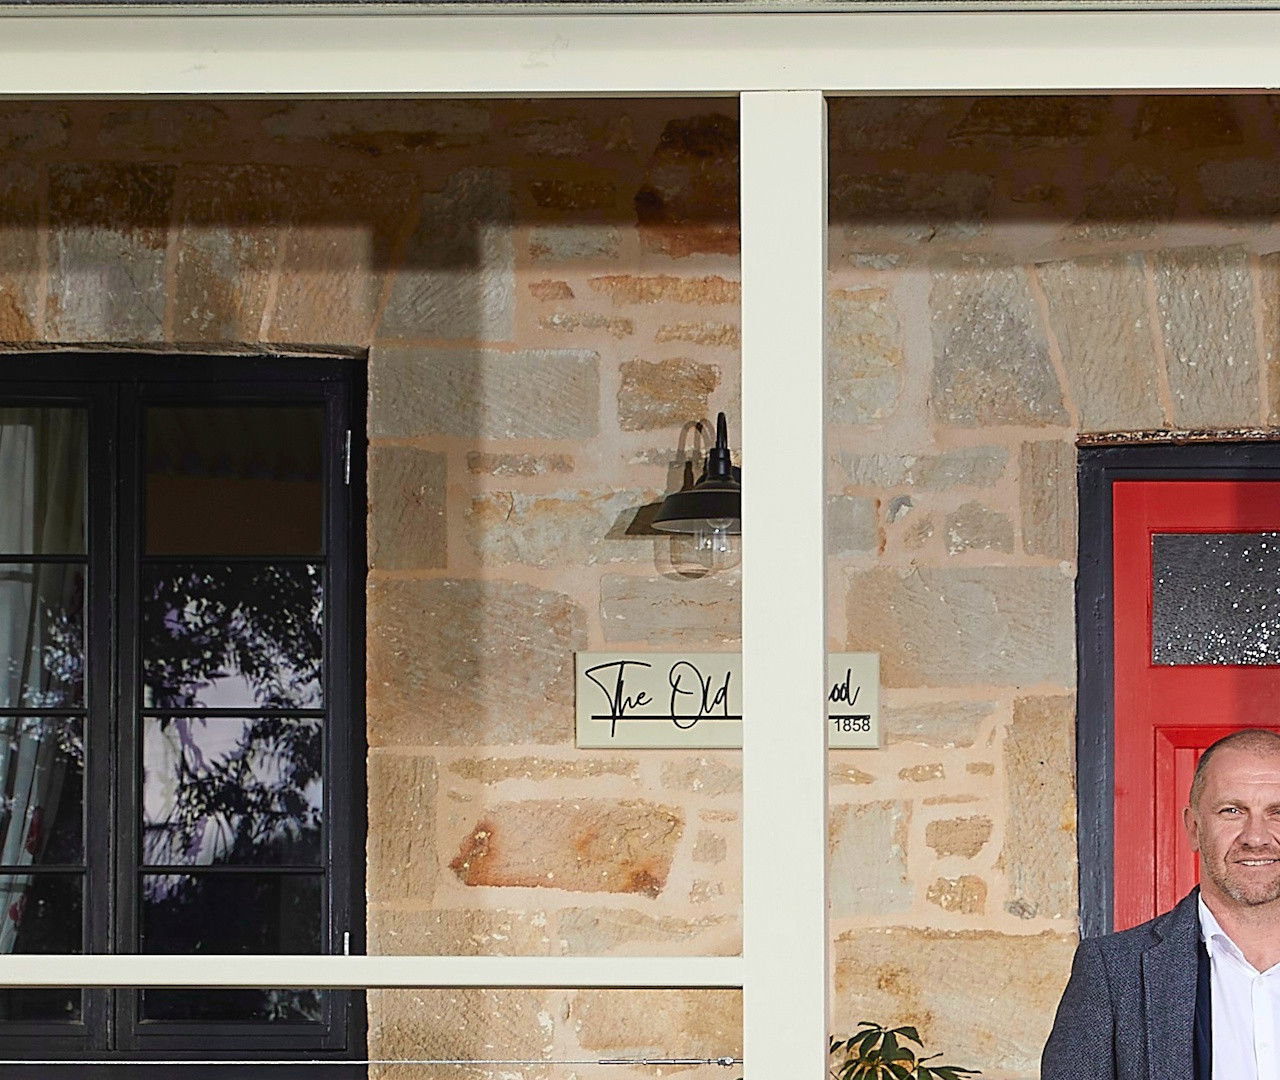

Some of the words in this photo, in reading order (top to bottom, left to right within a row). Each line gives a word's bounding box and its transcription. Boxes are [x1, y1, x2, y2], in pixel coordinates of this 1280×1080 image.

[585, 660, 653, 737] The
[669, 661, 731, 729] Old
[834, 718, 871, 732] 1858
